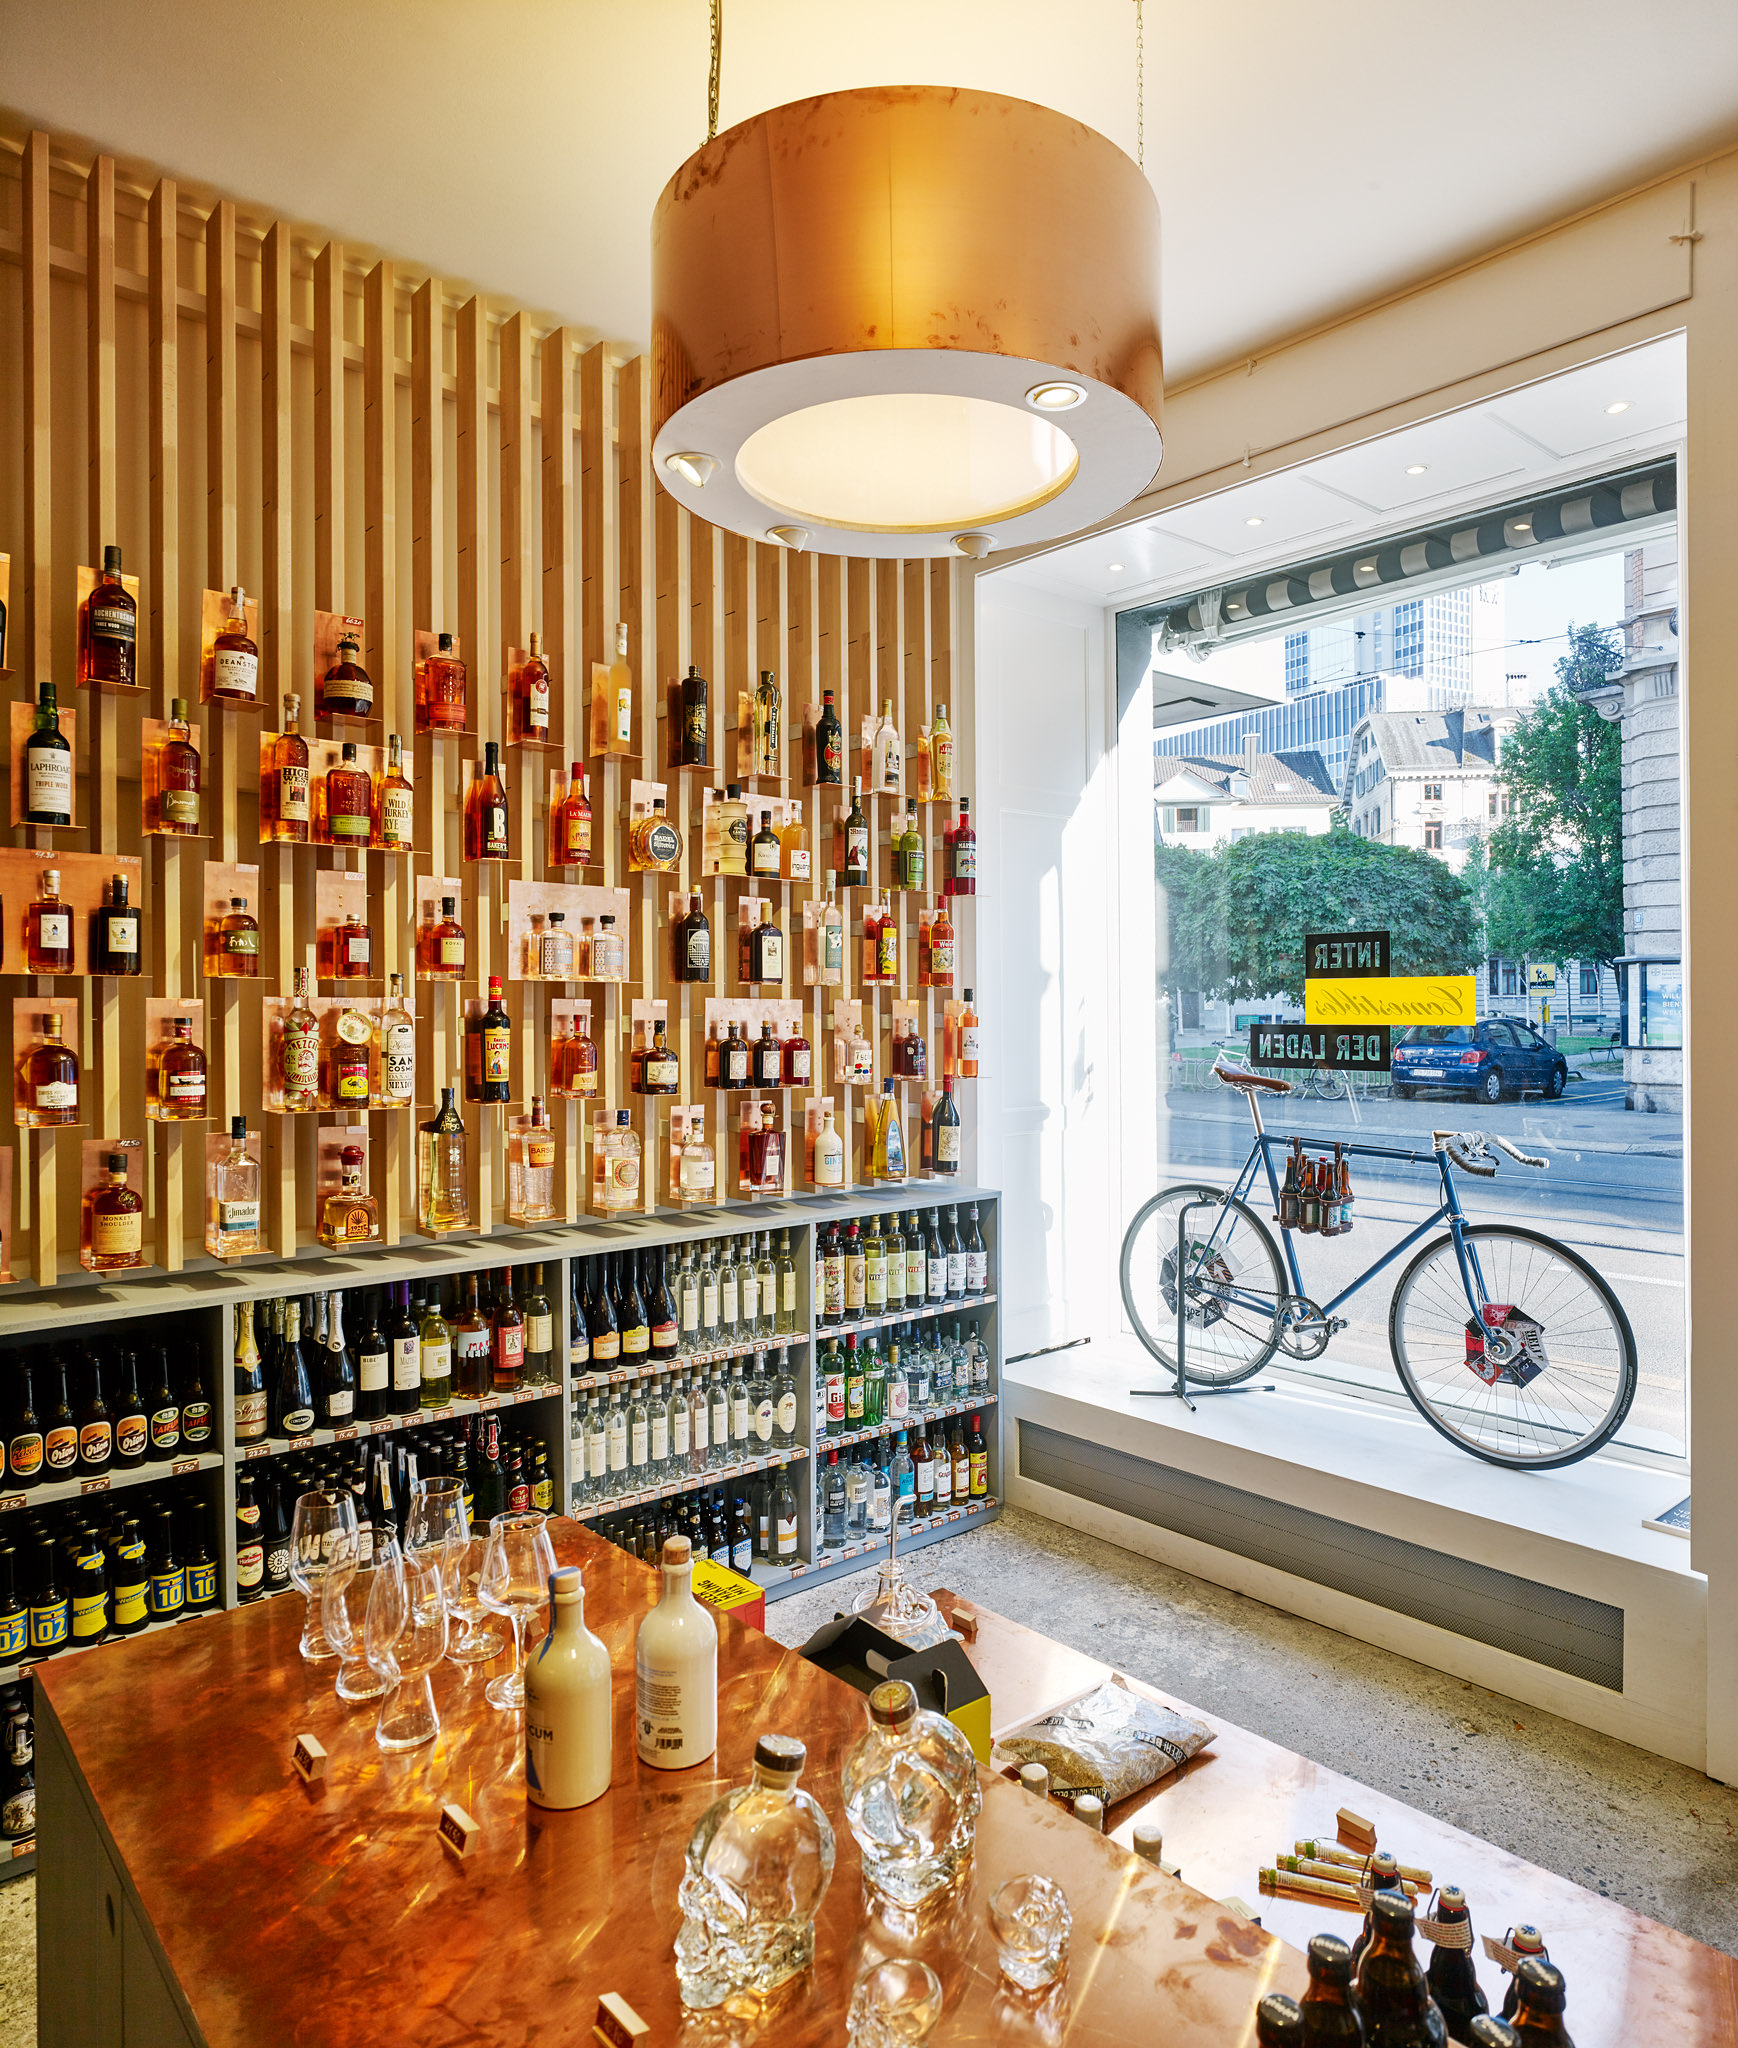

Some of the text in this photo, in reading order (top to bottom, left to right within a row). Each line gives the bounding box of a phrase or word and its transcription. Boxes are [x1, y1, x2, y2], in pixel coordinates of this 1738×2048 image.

[387, 798, 407, 809] WILD
[383, 806, 409, 819] TURKEY
[384, 817, 400, 830] RYE
[824, 1156, 837, 1166] GIN
[102, 1215, 131, 1223] MONKEY
[228, 1206, 257, 1219] Jimador
[100, 1220, 134, 1228] SHOULDER
[86, 1440, 109, 1457] Orion
[122, 1434, 146, 1450] Orion
[51, 1447, 75, 1462] Orion
[195, 1575, 216, 1598] 10
[159, 1583, 183, 1607] 10
[38, 1616, 65, 1641] 02
